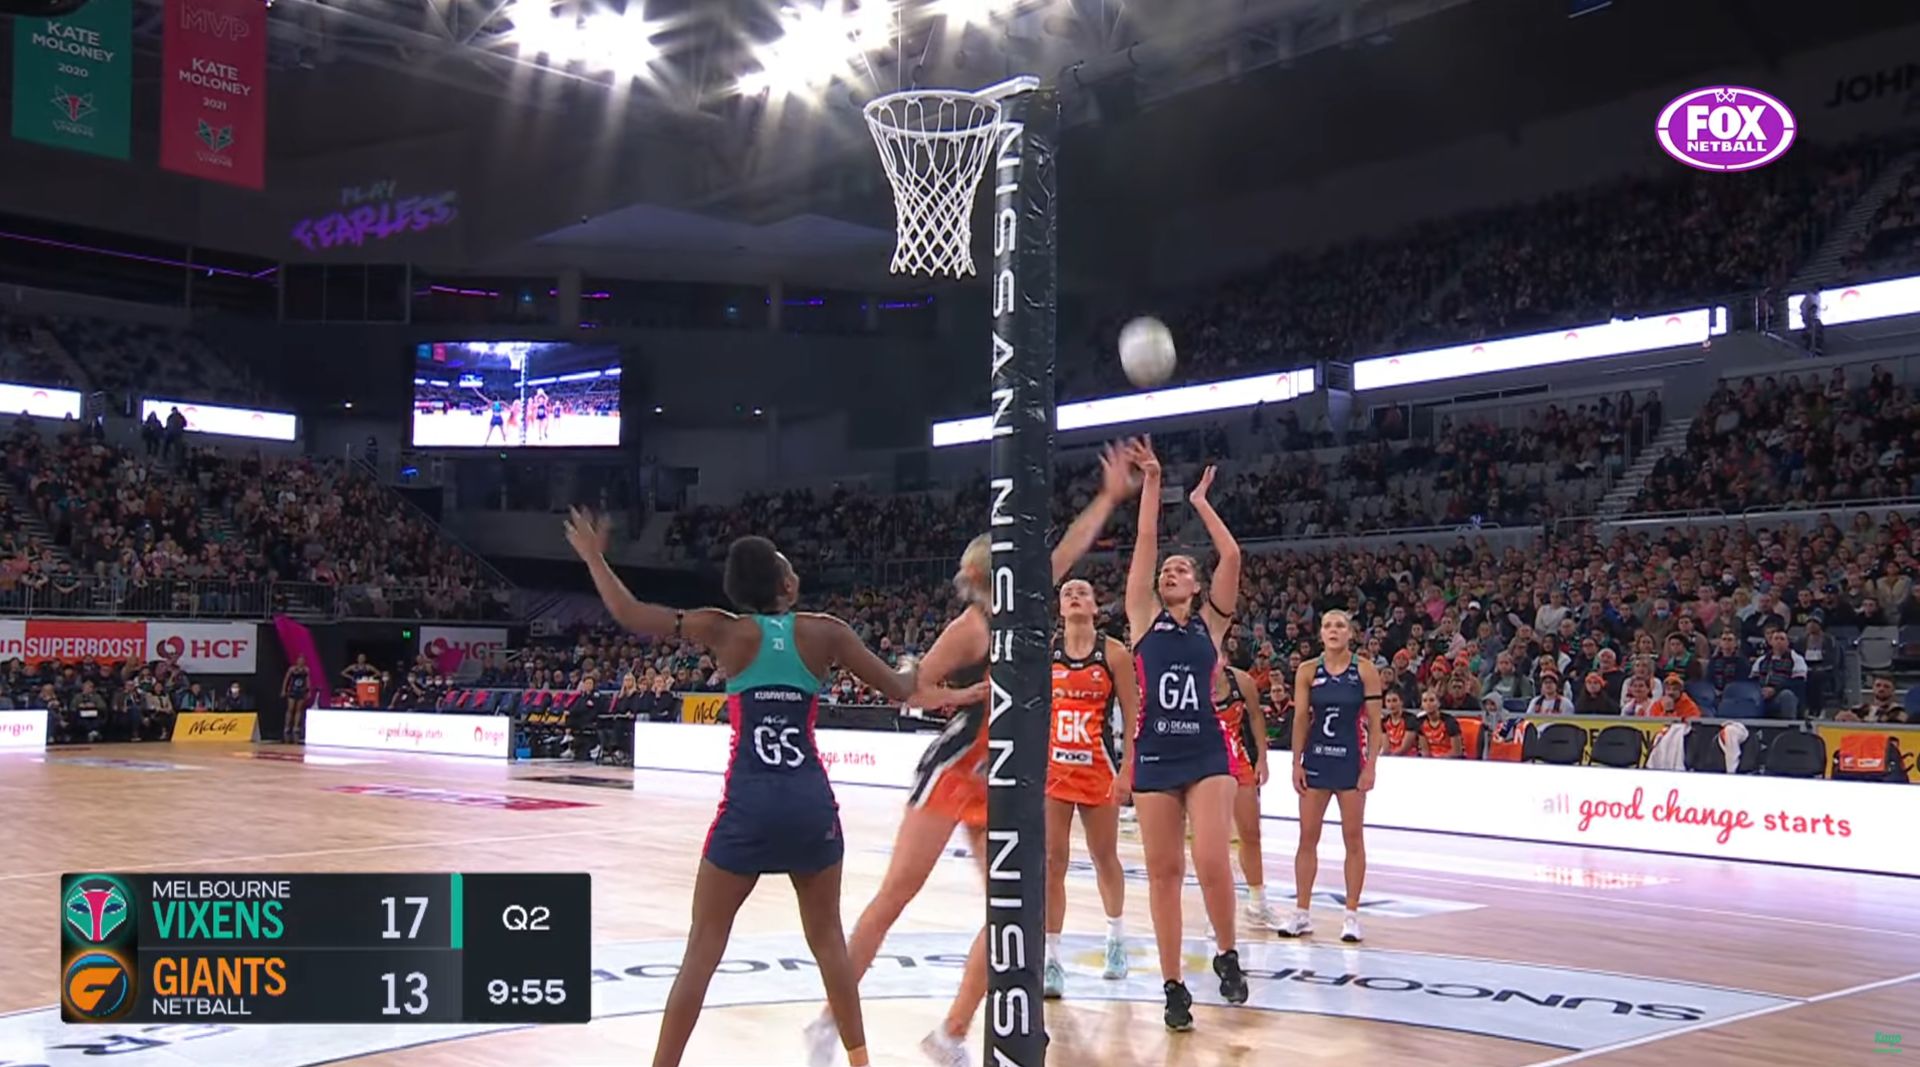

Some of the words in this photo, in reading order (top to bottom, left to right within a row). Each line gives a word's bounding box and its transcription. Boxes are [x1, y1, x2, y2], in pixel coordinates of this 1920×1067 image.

[47, 21, 100, 46] KATE
[180, 4, 249, 41] MVP
[32, 32, 115, 63] MOLONEY
[58, 62, 89, 78] 2020
[179, 70, 251, 96] MOLONEY
[192, 57, 238, 81] KATE
[203, 97, 227, 111] 2021
[291, 191, 458, 250] FEARLESS
[991, 121, 1024, 435] NISSAN
[989, 477, 1016, 788] NISSAN
[26, 637, 144, 658] SUPERBOOST
[191, 639, 248, 659] HCF
[754, 691, 803, 701] KUMWENDA
[1159, 672, 1200, 711] GA
[1057, 710, 1093, 744] GK
[1323, 712, 1339, 737] C
[754, 726, 805, 767] GS
[820, 752, 841, 773] nge
[843, 751, 876, 766] starts
[1543, 793, 1570, 815] all
[1578, 787, 1645, 831] good
[1652, 789, 1754, 844] change
[1763, 810, 1852, 837] starts
[1243, 967, 1706, 1021] SUNCORP
